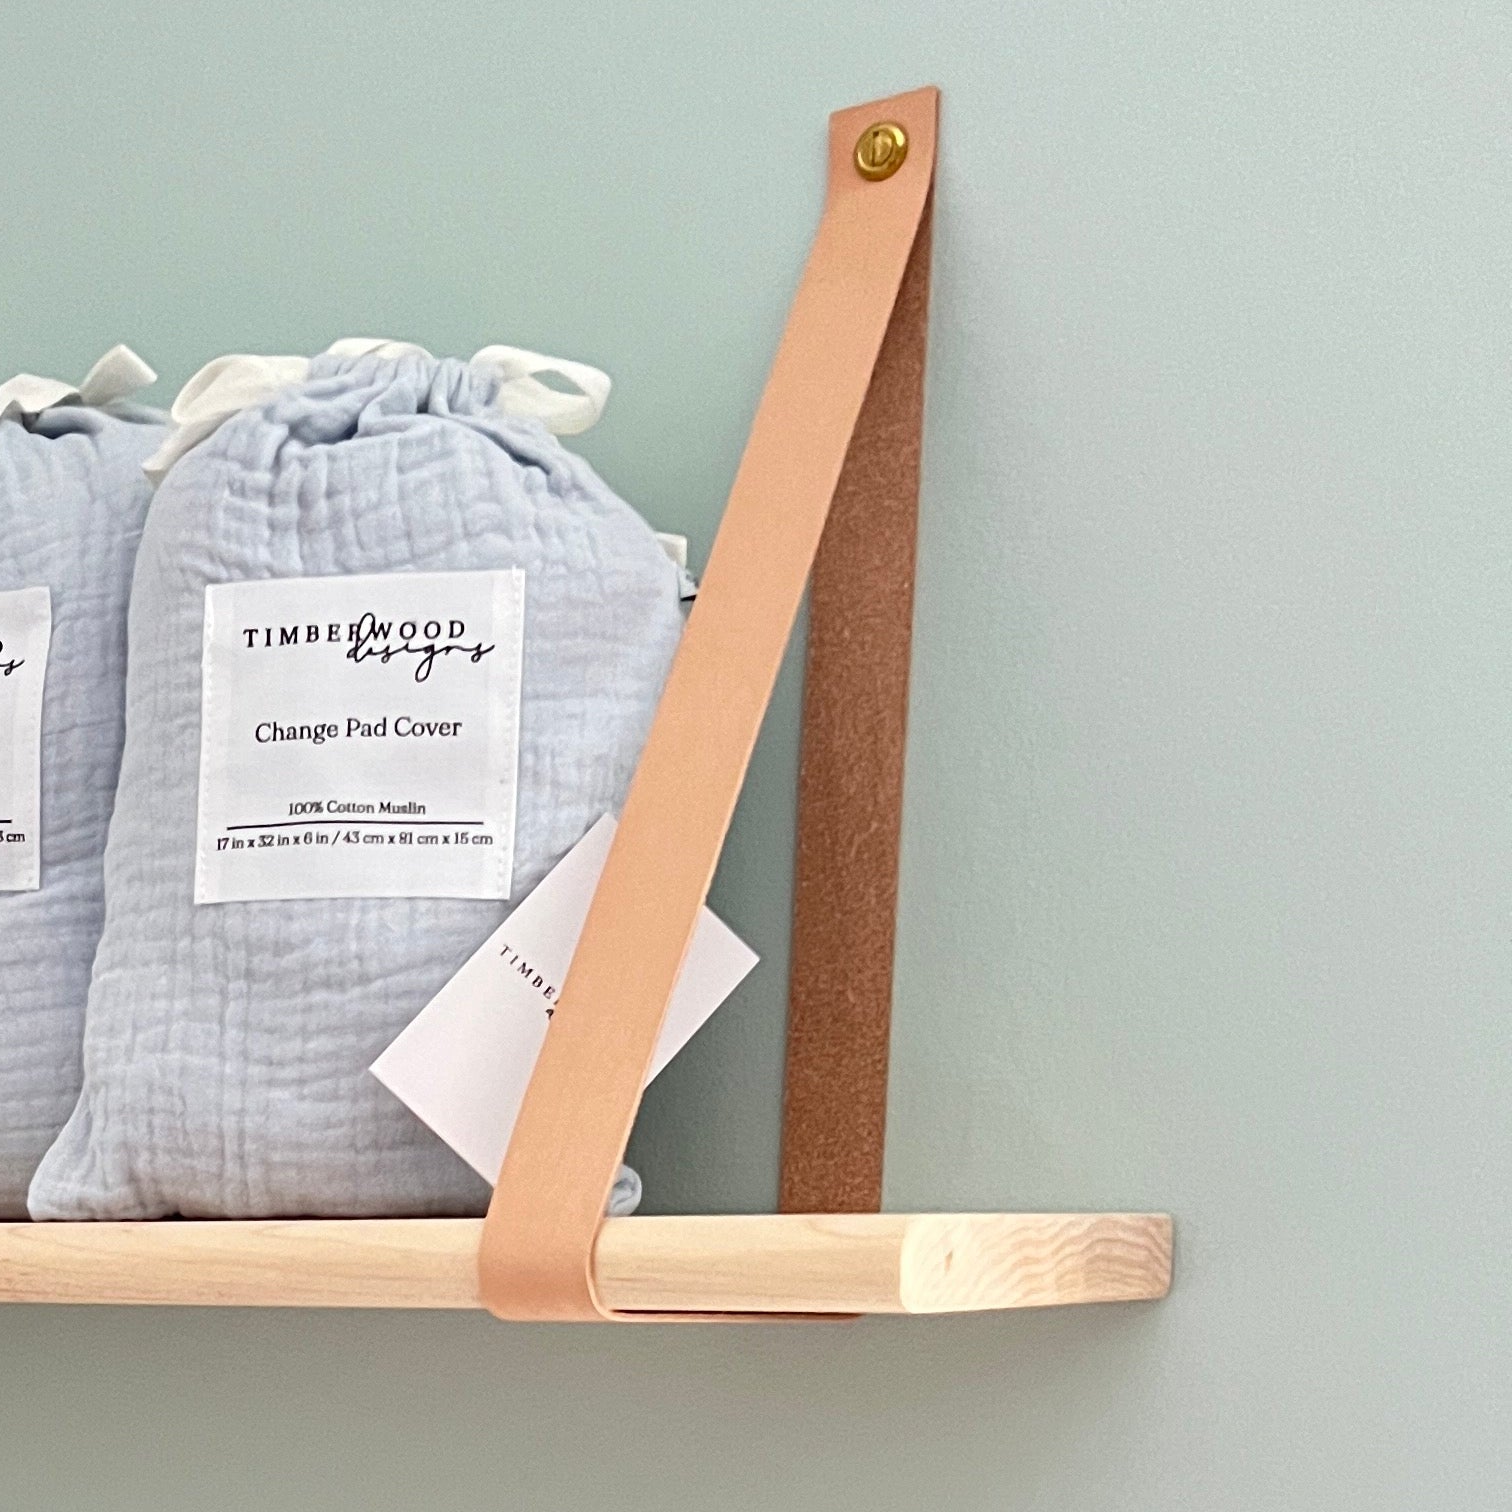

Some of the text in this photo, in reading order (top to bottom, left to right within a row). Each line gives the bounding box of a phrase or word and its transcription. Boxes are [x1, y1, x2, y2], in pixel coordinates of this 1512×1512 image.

[346, 612, 495, 683] designs
[255, 717, 462, 744] Change Pad Cover
[289, 800, 425, 815] 100% Cotton Muslin
[5, 833, 26, 843] cm
[217, 837, 230, 851] 17
[231, 837, 245, 850] in
[246, 838, 256, 849] x
[257, 834, 275, 848] 32
[276, 834, 290, 847] in
[292, 835, 301, 846] x
[315, 832, 329, 845] in
[342, 831, 360, 844] 43
[362, 834, 385, 845] cm
[387, 835, 396, 845] x
[416, 834, 439, 845] cm
[441, 835, 450, 845] x
[471, 834, 494, 846] cm
[500, 944, 559, 1005] TIMBE
